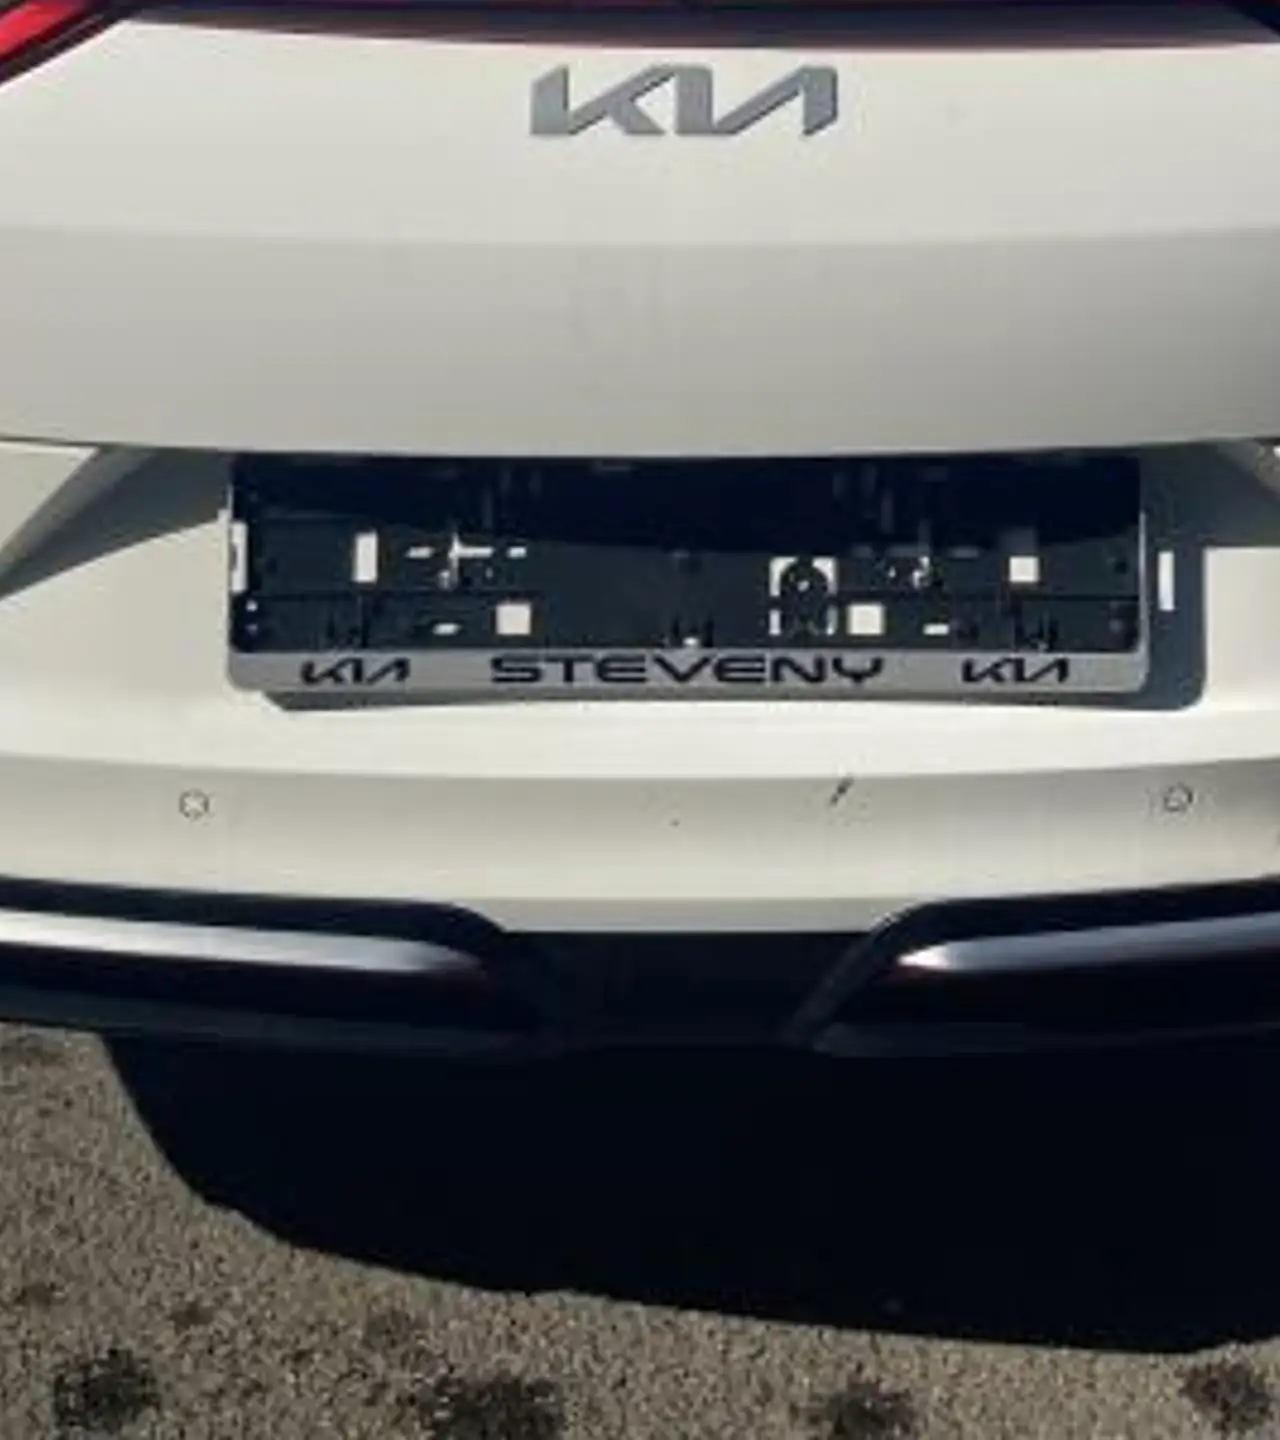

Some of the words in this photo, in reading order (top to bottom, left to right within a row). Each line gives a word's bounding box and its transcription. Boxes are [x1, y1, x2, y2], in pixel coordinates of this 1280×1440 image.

[530, 63, 838, 136] KIA
[300, 657, 412, 686] KIA
[489, 654, 884, 686] STEVENY
[961, 657, 1071, 686] KIA
